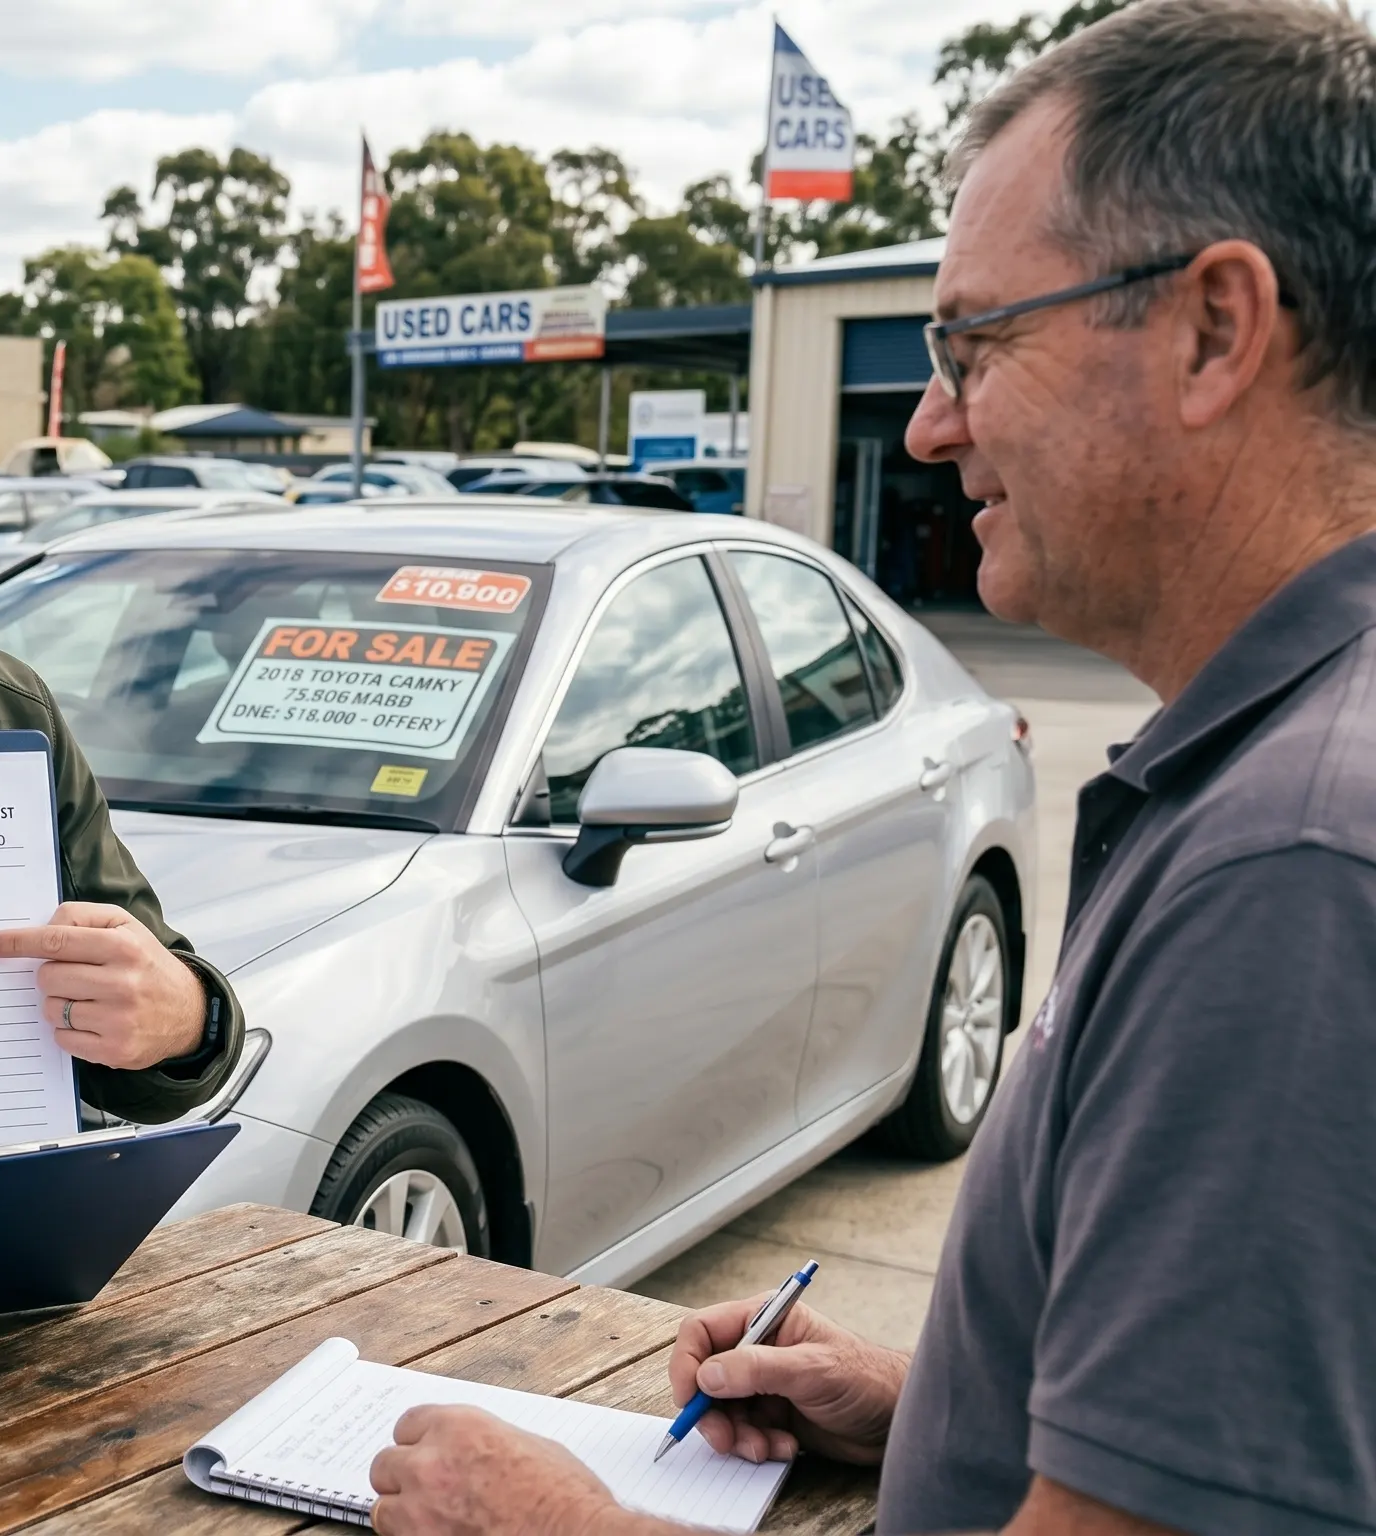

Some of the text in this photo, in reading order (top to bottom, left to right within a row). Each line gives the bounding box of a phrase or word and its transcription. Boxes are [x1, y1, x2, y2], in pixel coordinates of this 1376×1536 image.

[778, 75, 844, 107] USE
[775, 118, 846, 149] CARS
[383, 307, 451, 340] USED
[461, 301, 533, 335] CARS
[392, 578, 519, 605] $10,900
[263, 628, 492, 669] FOR SALE
[256, 667, 304, 682] 2018
[311, 669, 383, 687] TOYOTA
